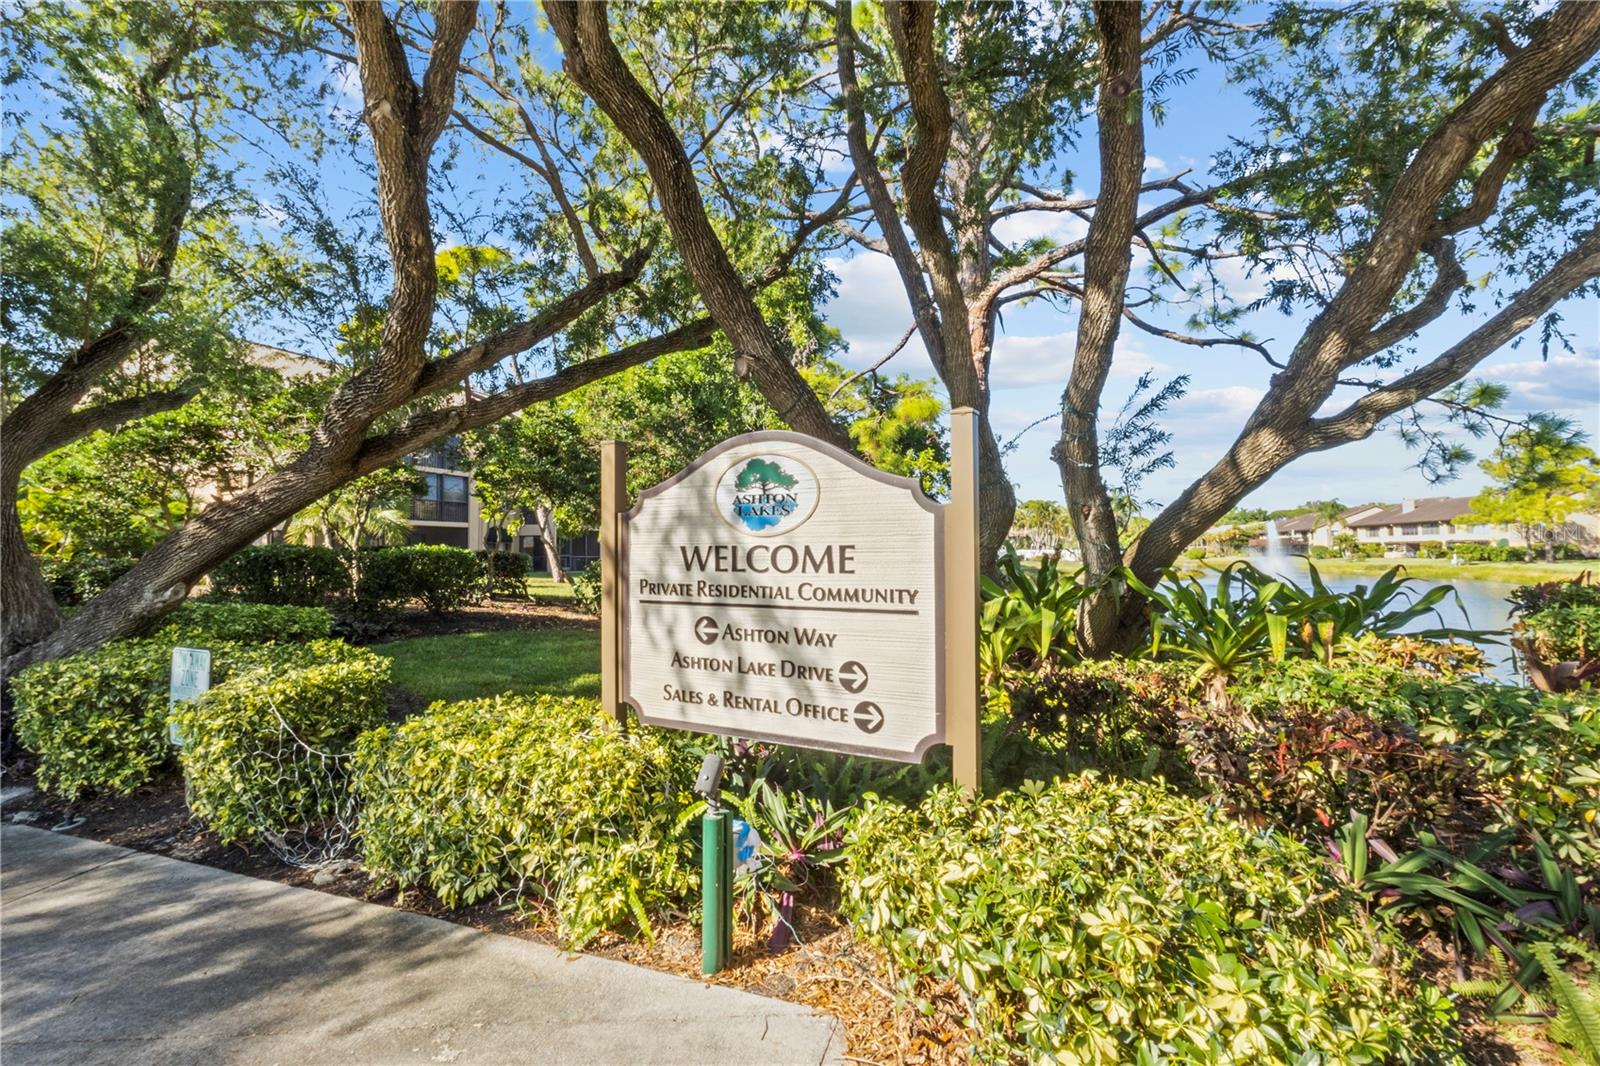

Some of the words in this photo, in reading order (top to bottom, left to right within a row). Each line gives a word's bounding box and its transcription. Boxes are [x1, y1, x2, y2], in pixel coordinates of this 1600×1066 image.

[733, 493, 799, 507] ASHTON
[735, 505, 790, 517] LAKES
[680, 545, 856, 574] WELCOME
[639, 579, 693, 598] PRIVATE
[697, 580, 794, 600] RESIDENTIAL
[798, 582, 919, 605] COMMUNITY
[722, 623, 789, 644] ASHTON
[794, 627, 837, 648] WAY
[671, 651, 733, 673] ASHTON
[738, 656, 776, 677] LAKE
[781, 659, 834, 683] DRIVE
[663, 684, 703, 704] SALES
[708, 692, 719, 706] &
[723, 690, 782, 714] RENTAL
[786, 698, 849, 723] OFFICE
